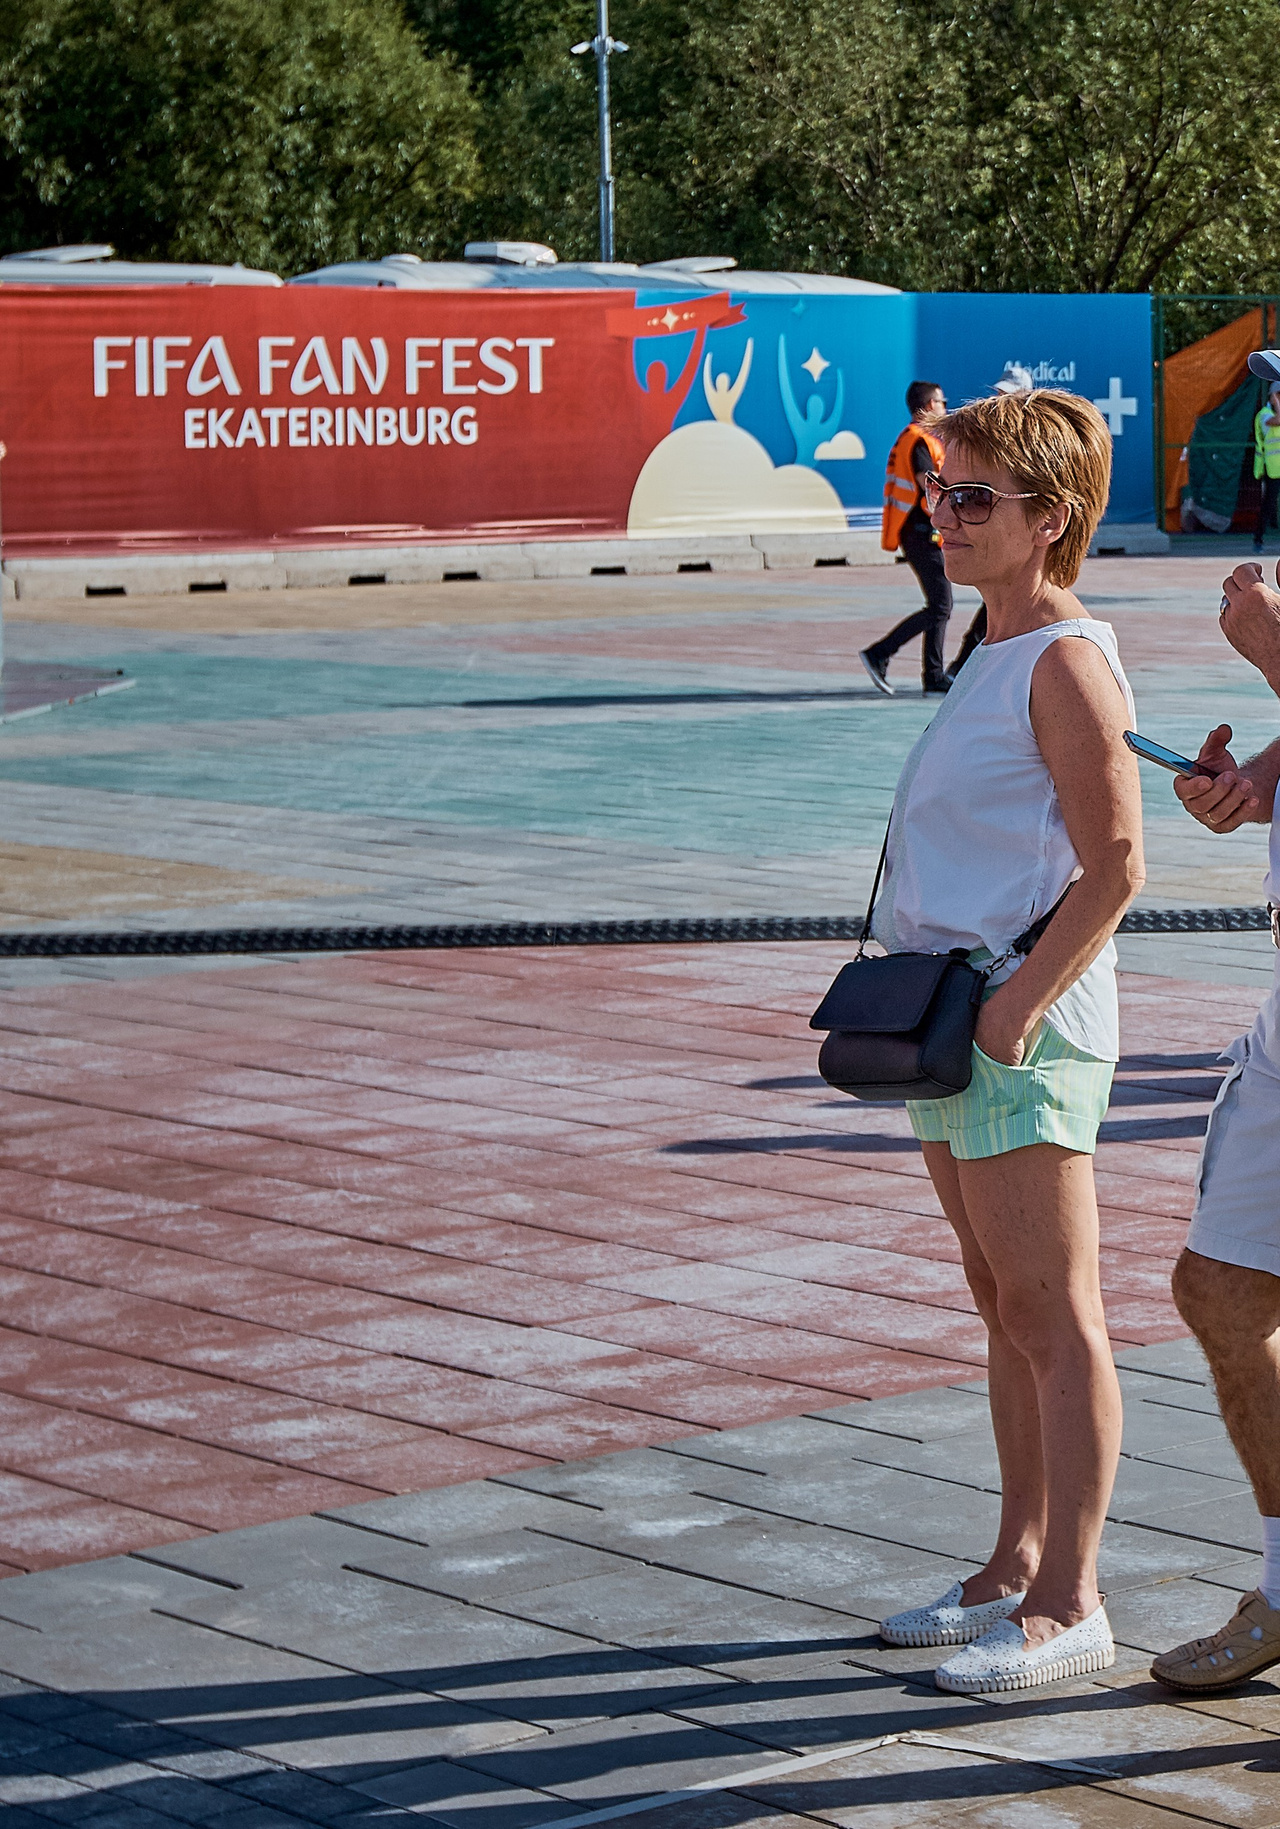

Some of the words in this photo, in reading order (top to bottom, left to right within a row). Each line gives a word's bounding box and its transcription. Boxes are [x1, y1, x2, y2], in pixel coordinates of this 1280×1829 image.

[93, 335, 242, 397] FIFA
[258, 335, 389, 396] FAN
[405, 336, 555, 395] FEST
[184, 406, 478, 449] EKATERINBURG
